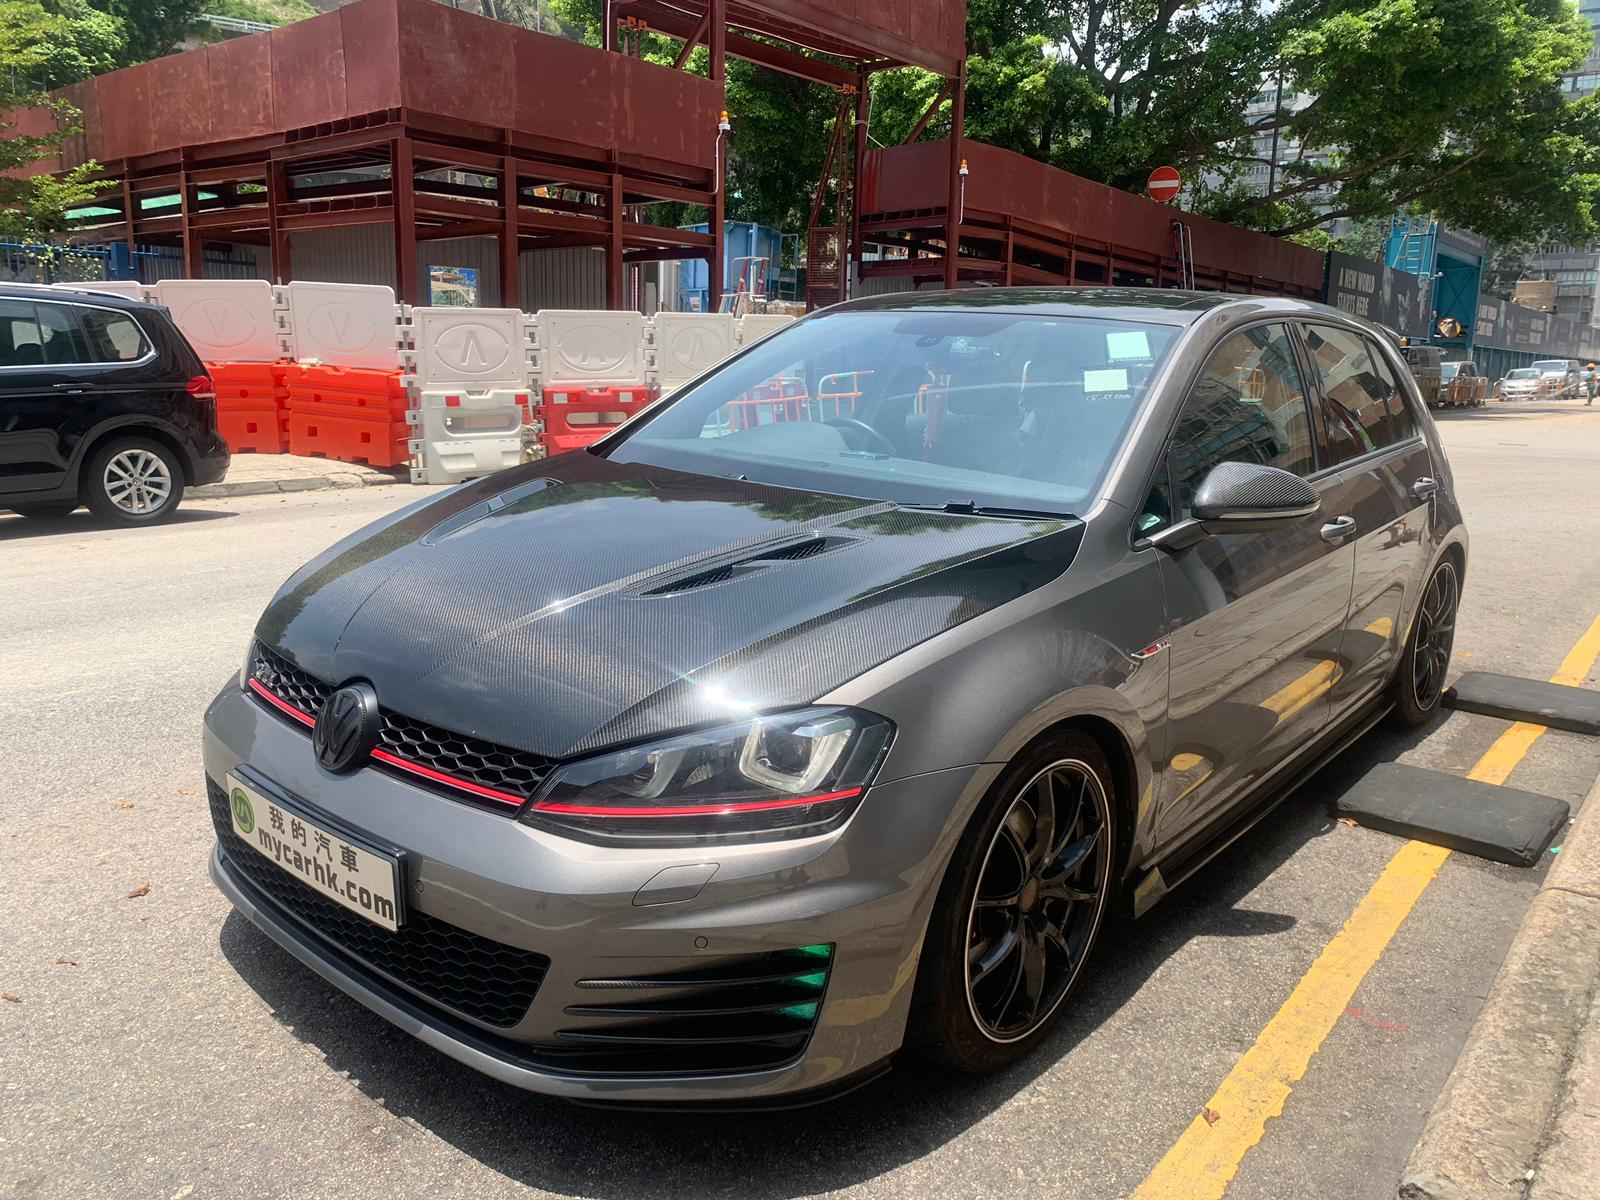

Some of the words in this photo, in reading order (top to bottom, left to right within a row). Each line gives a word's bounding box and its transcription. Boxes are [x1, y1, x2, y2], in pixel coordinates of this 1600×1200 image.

[258, 826, 395, 922] mycarhk.com
[269, 805, 359, 873] 我的汽車
